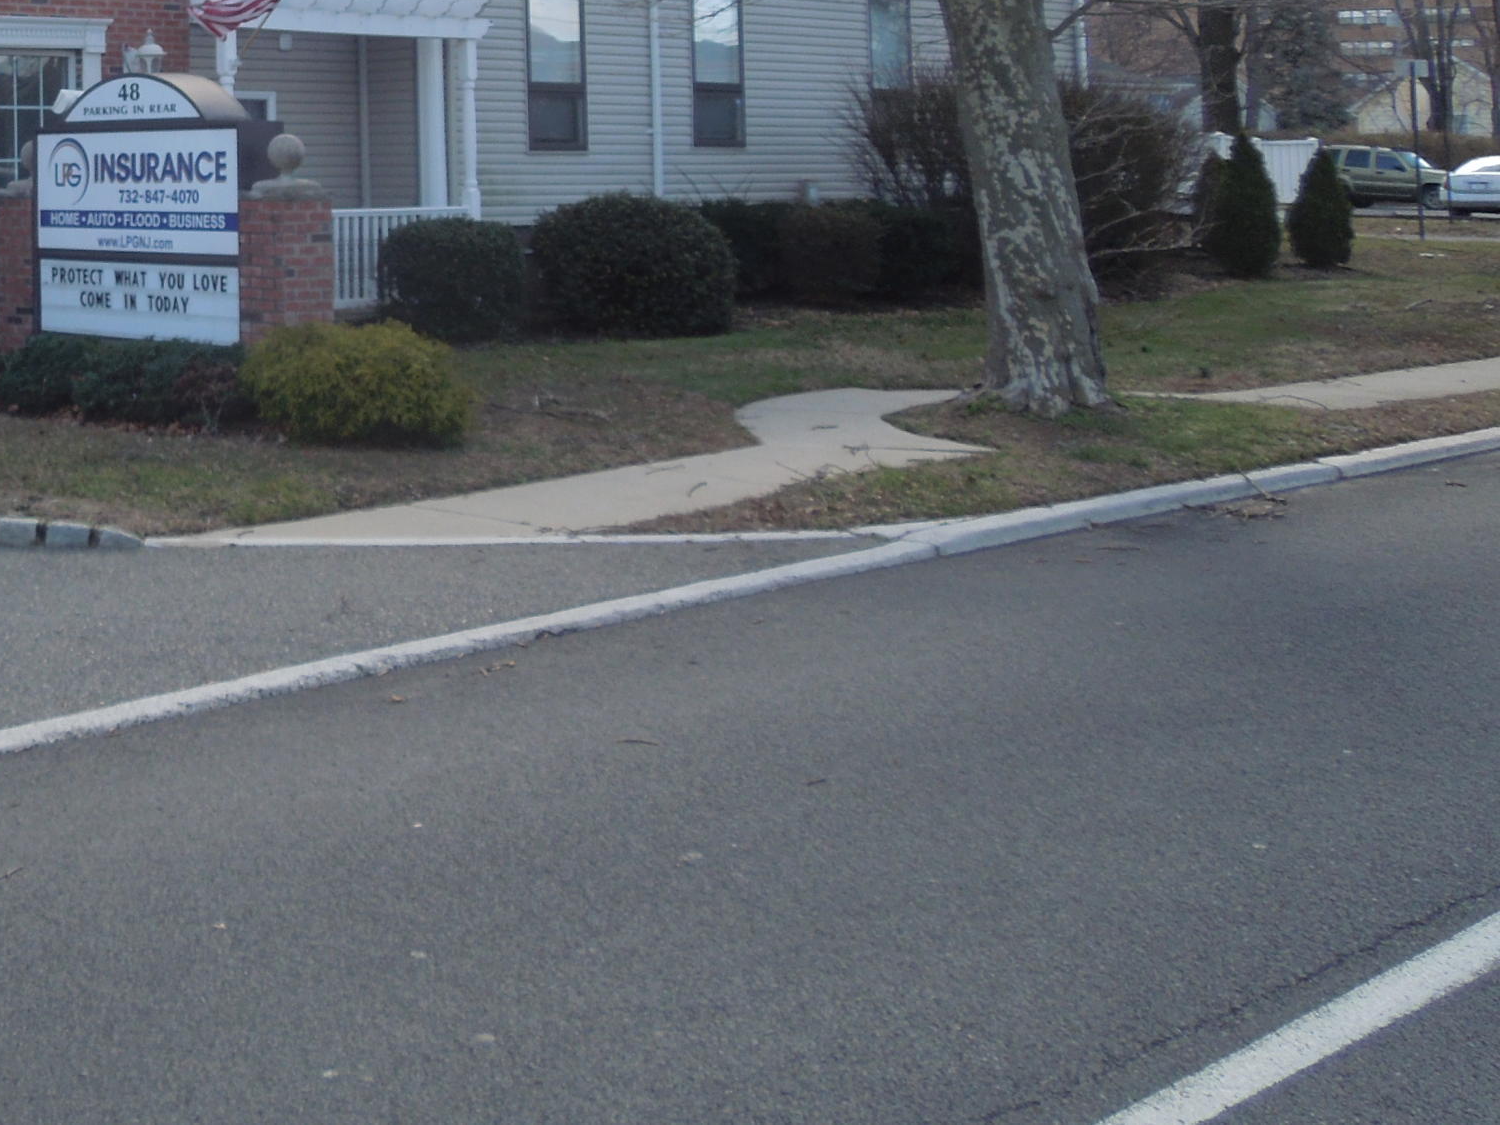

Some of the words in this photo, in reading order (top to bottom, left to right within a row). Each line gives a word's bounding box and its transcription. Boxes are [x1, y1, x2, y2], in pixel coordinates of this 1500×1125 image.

[118, 83, 140, 102] 48
[83, 105, 128, 116] PARKING
[133, 104, 145, 115] IN
[149, 103, 177, 114] REAR
[55, 163, 82, 187] LPG
[93, 151, 228, 184] INSURANCE
[118, 189, 200, 205] 732-847-4070
[50, 211, 80, 226] HOME
[87, 212, 116, 227] AUTO
[123, 213, 161, 227] FLOOD
[169, 214, 226, 229] BUSINESS
[98, 235, 174, 250] www.LPGNJ.com
[52, 267, 104, 285] PROTECT
[114, 270, 147, 287] WHAT
[159, 272, 185, 290] YOU
[193, 273, 228, 292] LOVE
[80, 290, 112, 308] COME
[124, 293, 137, 309] IN
[148, 295, 189, 314] TODAY
